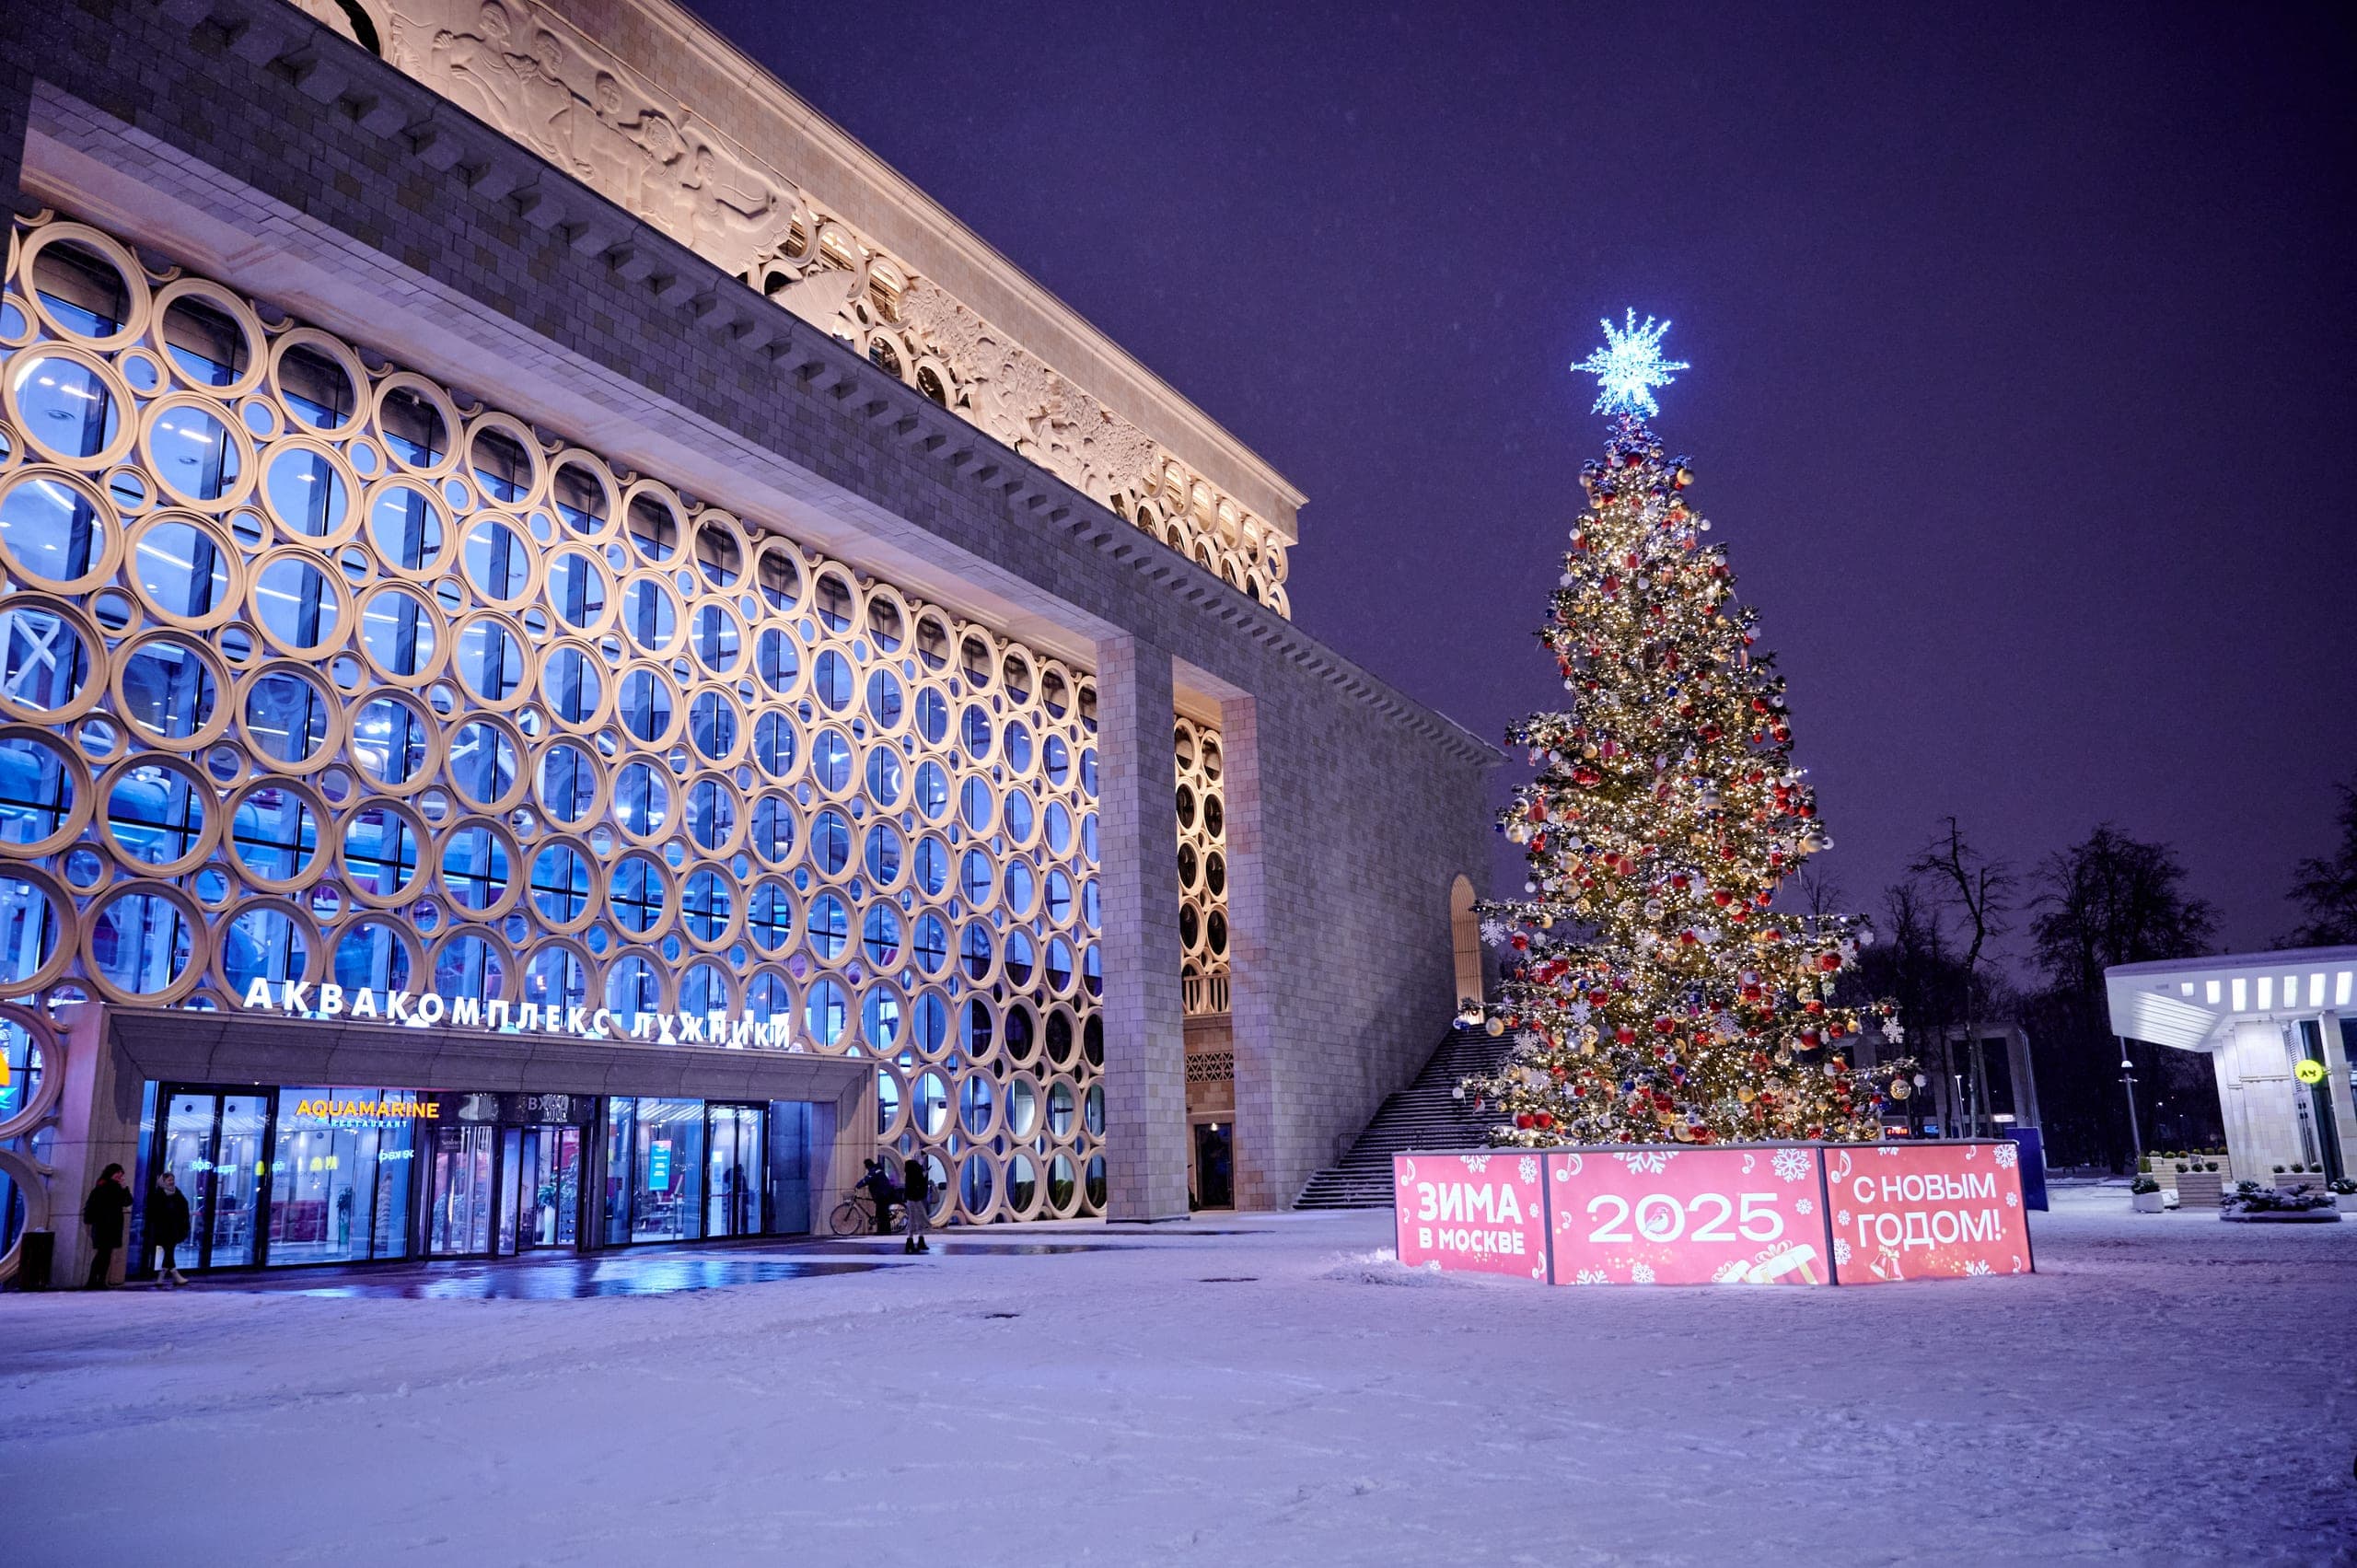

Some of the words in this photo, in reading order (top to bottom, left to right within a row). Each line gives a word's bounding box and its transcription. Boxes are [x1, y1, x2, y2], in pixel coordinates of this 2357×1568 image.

[243, 977, 610, 1036] АКВАКОМПЛЕКС
[631, 1012, 790, 1048] ЛУЖНИКИ
[296, 1099, 440, 1118] AQUAMARINE
[330, 1120, 408, 1128] RESTAURANT
[1418, 1181, 1522, 1224] ЗИМА
[1853, 1177, 1876, 1203] С
[1883, 1173, 1996, 1202] НОВЫМ
[1587, 1192, 1784, 1242] 2025
[1858, 1208, 2003, 1251] ГОДОМ!
[1419, 1227, 1433, 1249] В
[1438, 1228, 1526, 1254] МОСКВЕ
